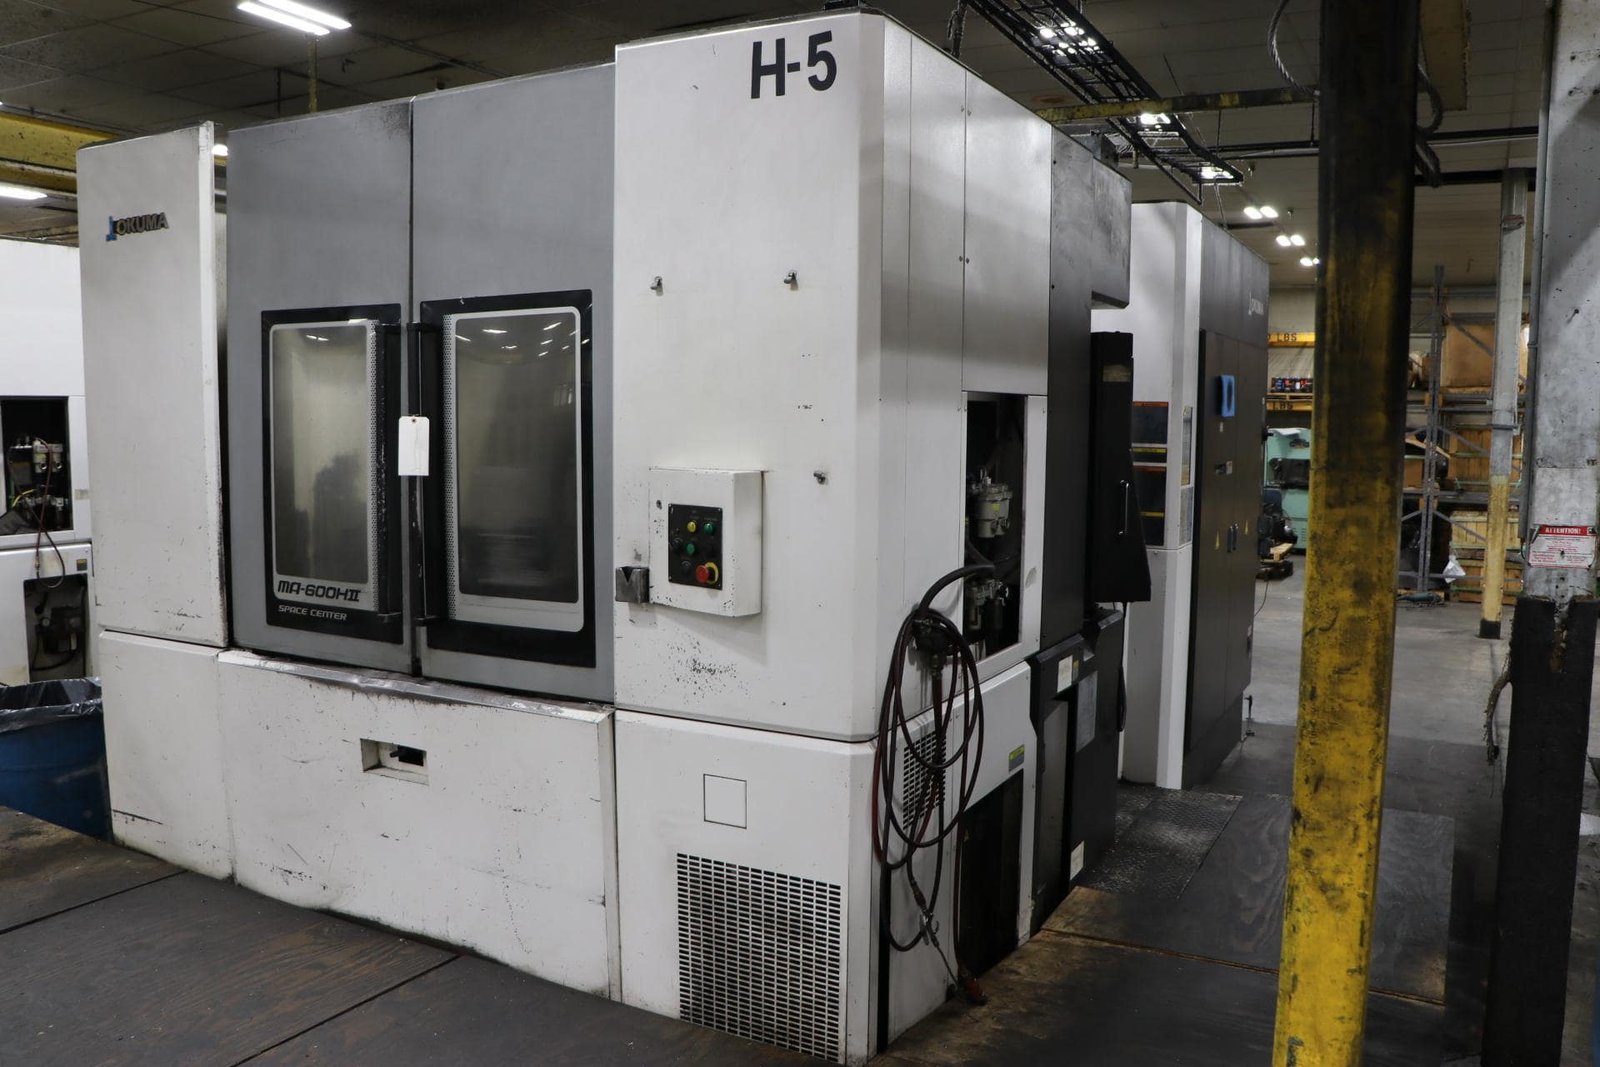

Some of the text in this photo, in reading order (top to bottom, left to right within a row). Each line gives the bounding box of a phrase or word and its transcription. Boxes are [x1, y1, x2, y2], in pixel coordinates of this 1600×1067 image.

[751, 30, 837, 100] H-5
[115, 212, 169, 236] OKUMA
[1276, 332, 1298, 342] LBS
[278, 604, 347, 620] SPACE CENTER
